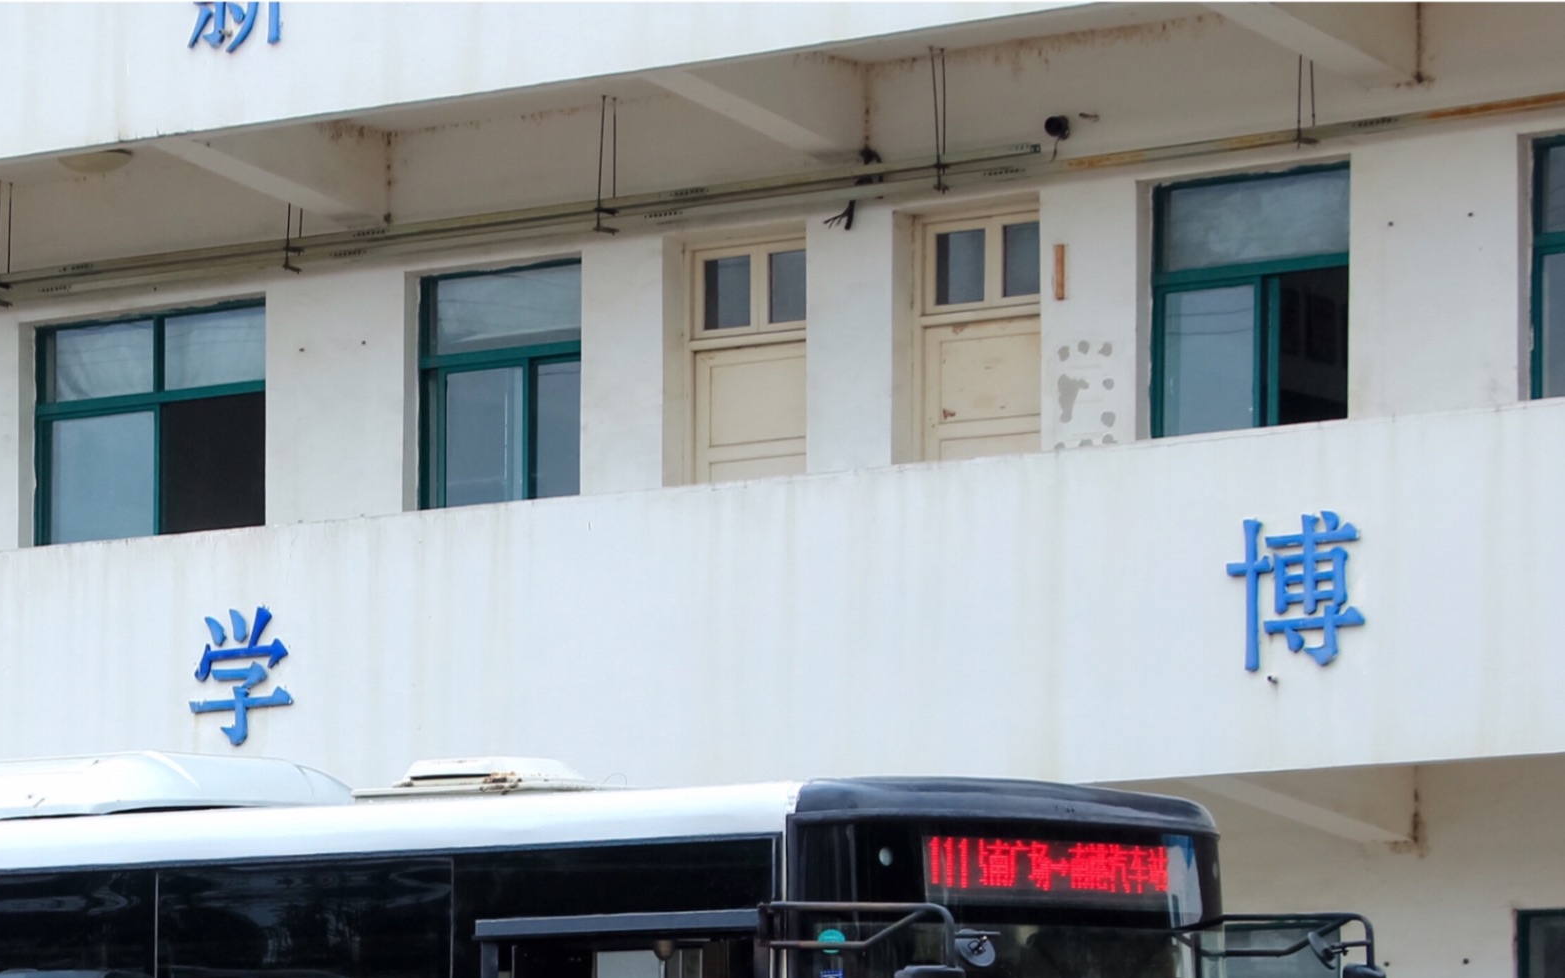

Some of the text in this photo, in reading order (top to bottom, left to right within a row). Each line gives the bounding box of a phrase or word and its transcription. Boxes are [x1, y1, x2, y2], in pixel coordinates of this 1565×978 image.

[189, 604, 294, 746] 学
[1226, 510, 1366, 672] 博
[929, 836, 969, 889] 111
